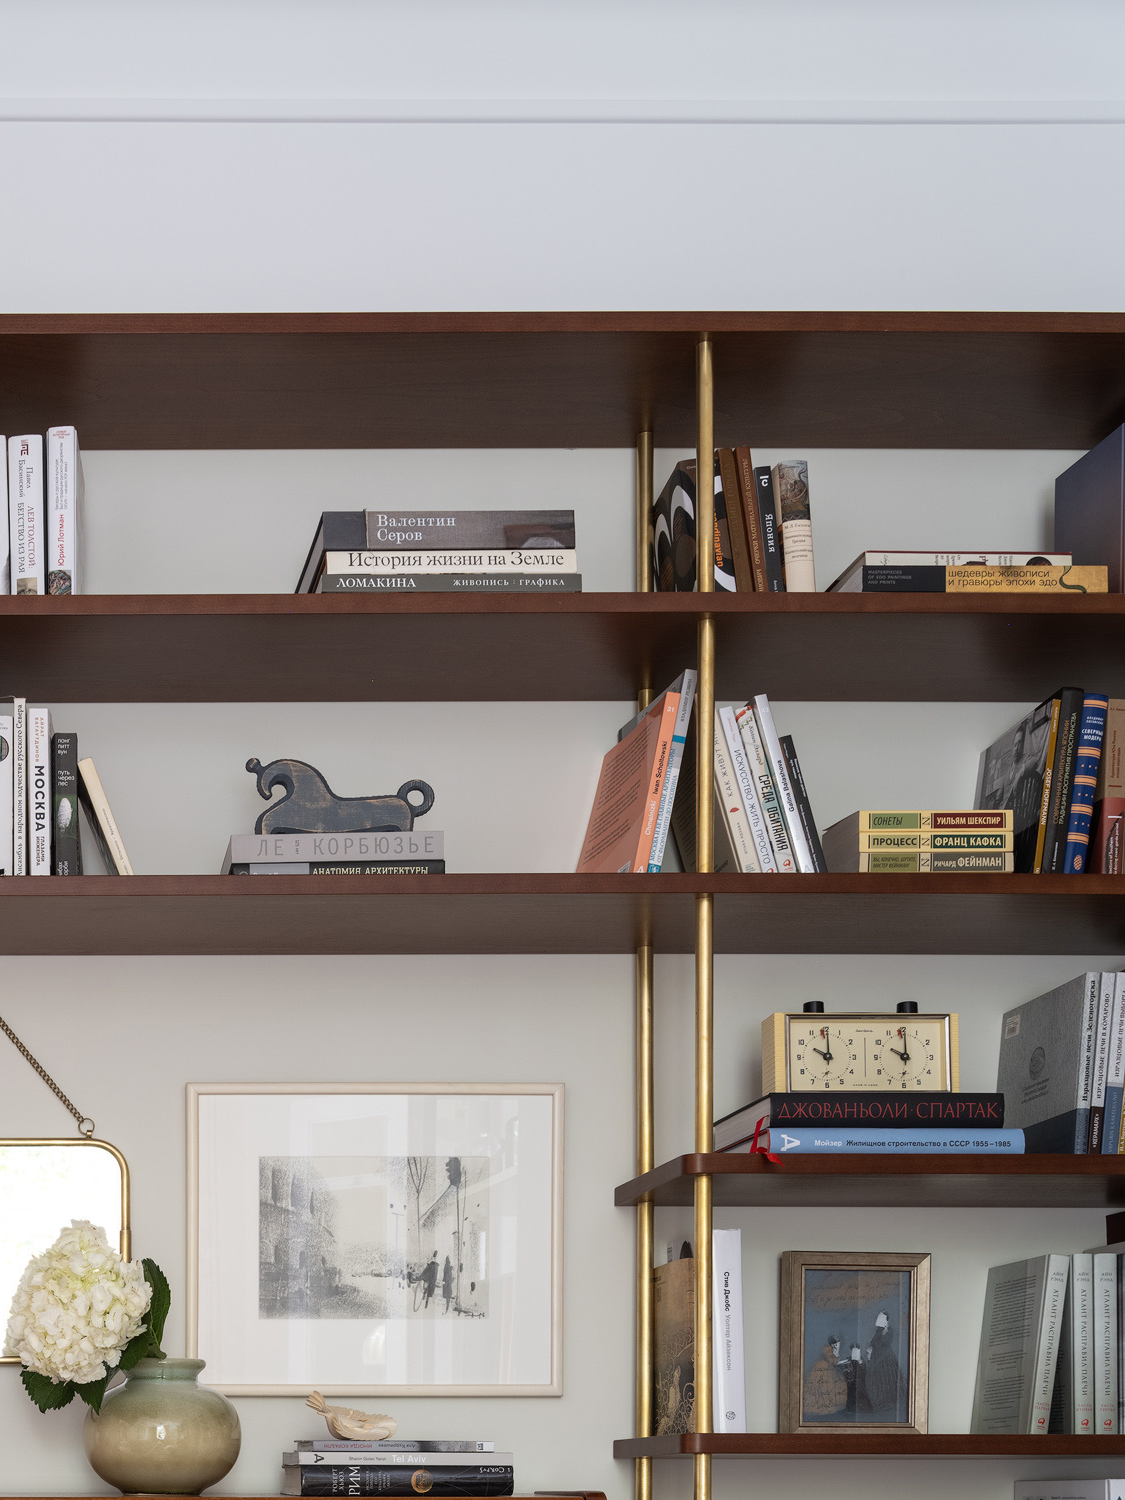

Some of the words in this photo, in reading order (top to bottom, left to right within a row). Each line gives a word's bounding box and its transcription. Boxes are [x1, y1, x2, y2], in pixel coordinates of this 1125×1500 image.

[377, 514, 456, 527] Валентин
[377, 528, 423, 544] Серов
[764, 514, 775, 553] Япония
[18, 542, 25, 554] ИЗ
[348, 552, 423, 569] История
[427, 554, 484, 566] жизни
[487, 554, 506, 566] на
[510, 551, 564, 566] Земле
[948, 569, 997, 579] шедевры
[998, 569, 1050, 578] живописи
[958, 579, 1003, 587] гравюры
[1006, 579, 1036, 587] эпохи
[1038, 578, 1058, 587] эдо
[337, 578, 416, 588] ЛОМАКИНА
[519, 579, 565, 587] ГРАФИКА
[715, 749, 730, 778] ЖИВУТ
[35, 765, 45, 832] МОСКВА
[644, 800, 656, 835] Chmelnizki
[652, 779, 661, 795] Iwan
[734, 749, 753, 800] ИСКУССТВО
[747, 803, 760, 827] ЖИТЬ
[755, 829, 771, 864] ПРОСТО
[785, 794, 795, 812] Galina
[1041, 789, 1050, 825] HOFFMANN
[758, 774, 775, 803] СРЕДА
[767, 807, 789, 851] ОБИТАНИЯ
[873, 817, 903, 825] СОНЕТЫ
[937, 817, 966, 825] УИЛЬЯМ
[968, 816, 1001, 825] ШЕКСПИР
[257, 838, 284, 857] ЛЕ
[313, 836, 435, 855] КОРБЮЗЬЕ
[873, 838, 917, 846] ПРОЦЕСС
[935, 837, 967, 847] ФРАНЦ
[970, 837, 1001, 846] КАФКА
[313, 867, 362, 875] АНАТОМИЯ
[365, 866, 429, 874] АРХИТЕКТУРЫ
[934, 860, 956, 868] РИЧАРД
[957, 856, 1002, 867] ФЕЙНМАН
[1082, 1055, 1091, 1102] Изразцовые
[1087, 980, 1096, 1033] Зеленогорска
[1096, 1056, 1105, 1099] ИЗРАЗЦОВЫЕ
[1102, 993, 1110, 1031] КОМАРОВО
[777, 1102, 908, 1118] ДЖОВАНЬОЛИ
[917, 1102, 998, 1118] СПАРТАК
[846, 1140, 885, 1148] Жилищное
[1050, 1289, 1059, 1319] АТЛАНТ
[1045, 1321, 1056, 1368] РАСПРАВИЛ
[391, 1455, 405, 1463] Tel
[407, 1455, 427, 1463] Aviv
[348, 1466, 360, 1496] РИМ
